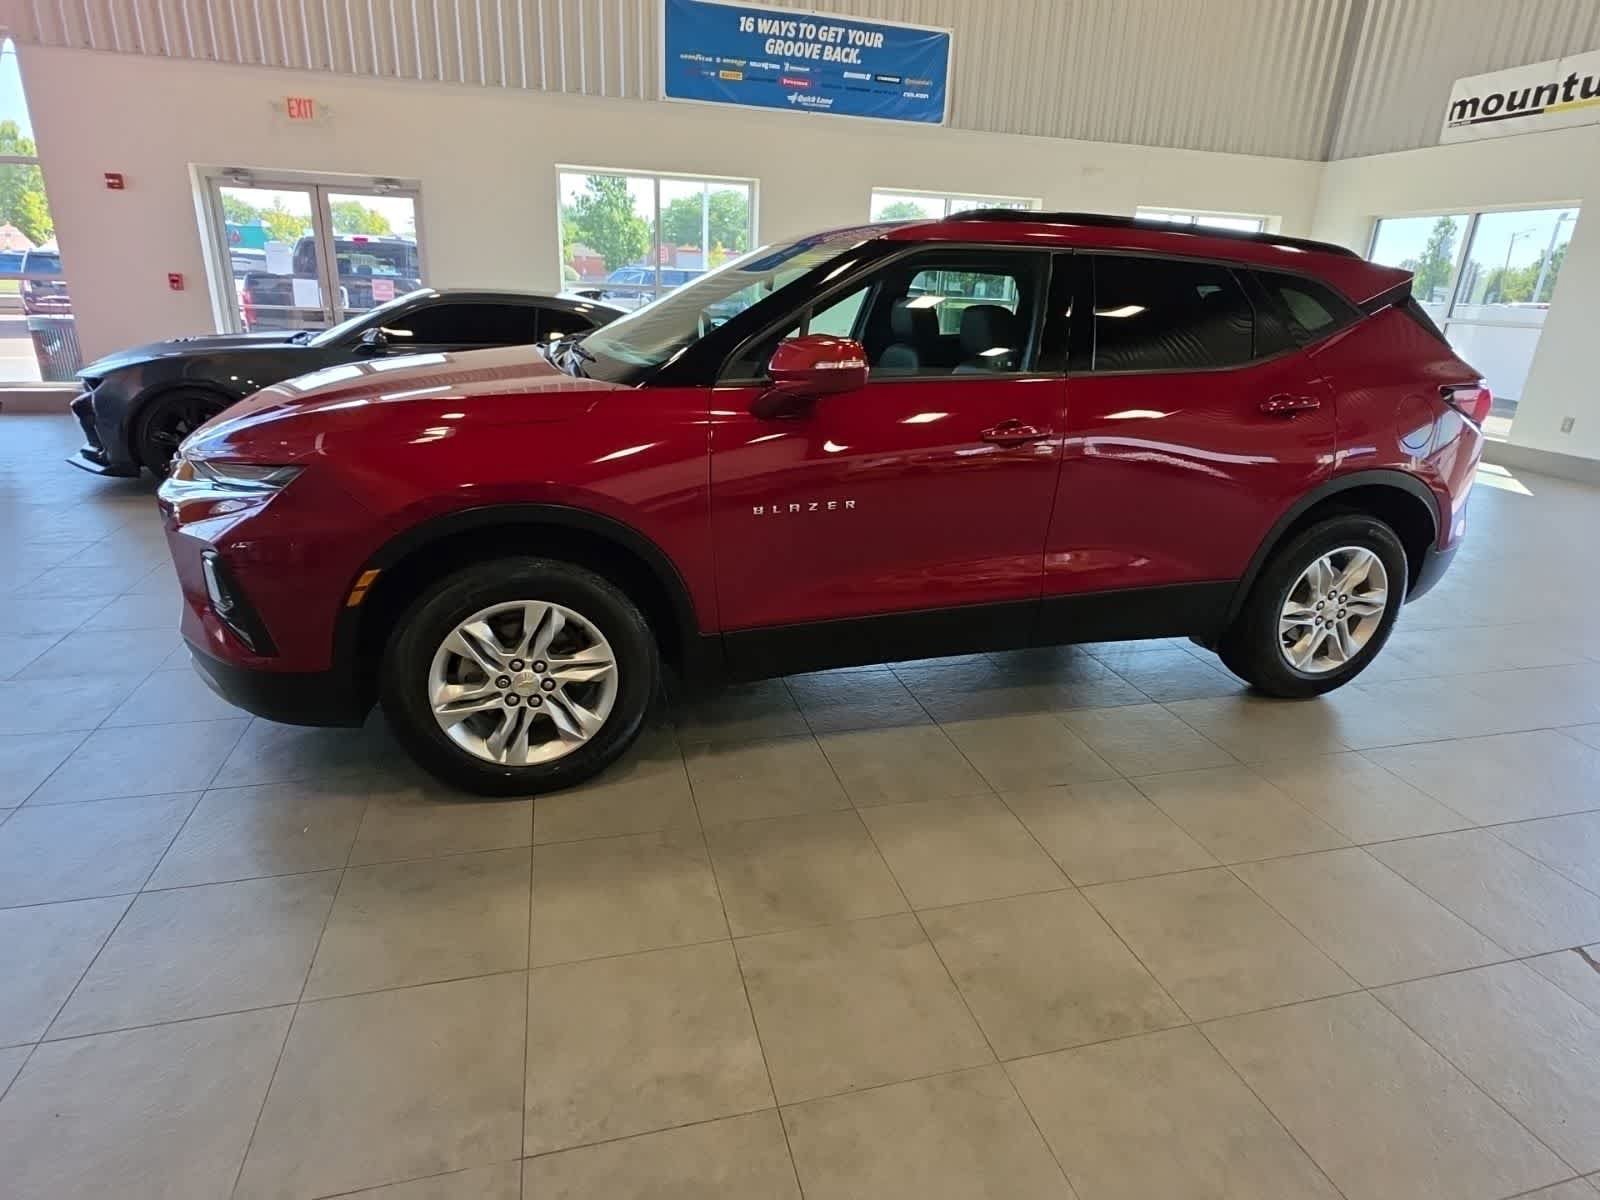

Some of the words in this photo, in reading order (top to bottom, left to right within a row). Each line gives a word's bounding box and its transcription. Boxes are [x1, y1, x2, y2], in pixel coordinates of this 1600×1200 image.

[739, 16, 754, 33] 16
[757, 18, 797, 38] WAYS
[799, 23, 816, 40] TO
[818, 26, 845, 43] GET
[848, 29, 884, 48] YOUR
[765, 38, 822, 60] GROOVE
[822, 45, 862, 65] BACK.
[287, 97, 314, 120] EXIT
[752, 500, 856, 515] BLAZER
